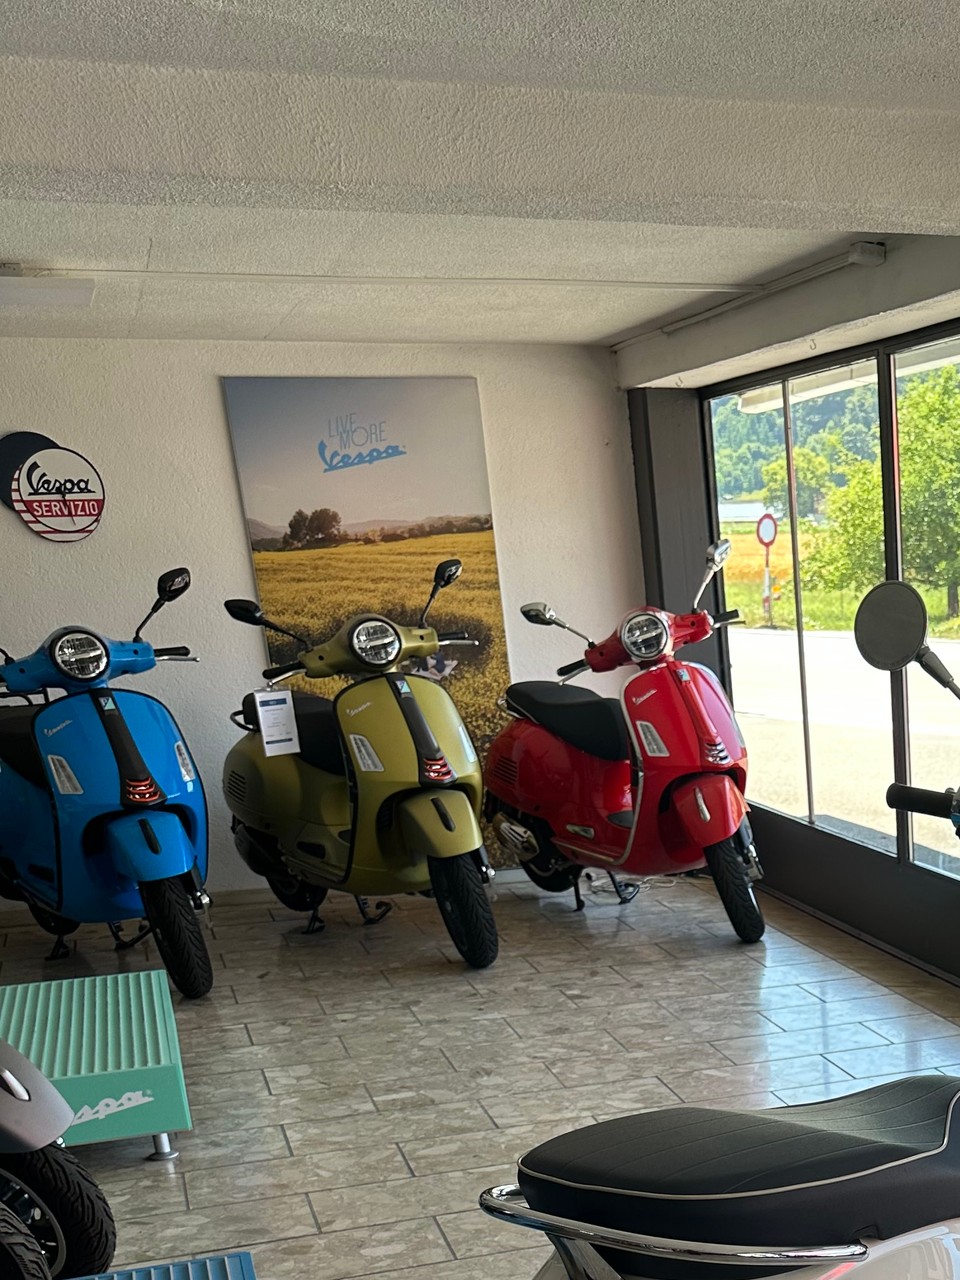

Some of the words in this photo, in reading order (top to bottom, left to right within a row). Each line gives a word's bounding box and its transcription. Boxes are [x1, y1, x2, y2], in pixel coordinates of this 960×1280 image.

[327, 412, 357, 438] LIVE
[339, 420, 388, 451] MORE
[317, 439, 407, 474] Vespa
[26, 460, 97, 498] Vespa
[32, 500, 99, 516] SERVIZIO
[70, 1090, 155, 1127] spa
